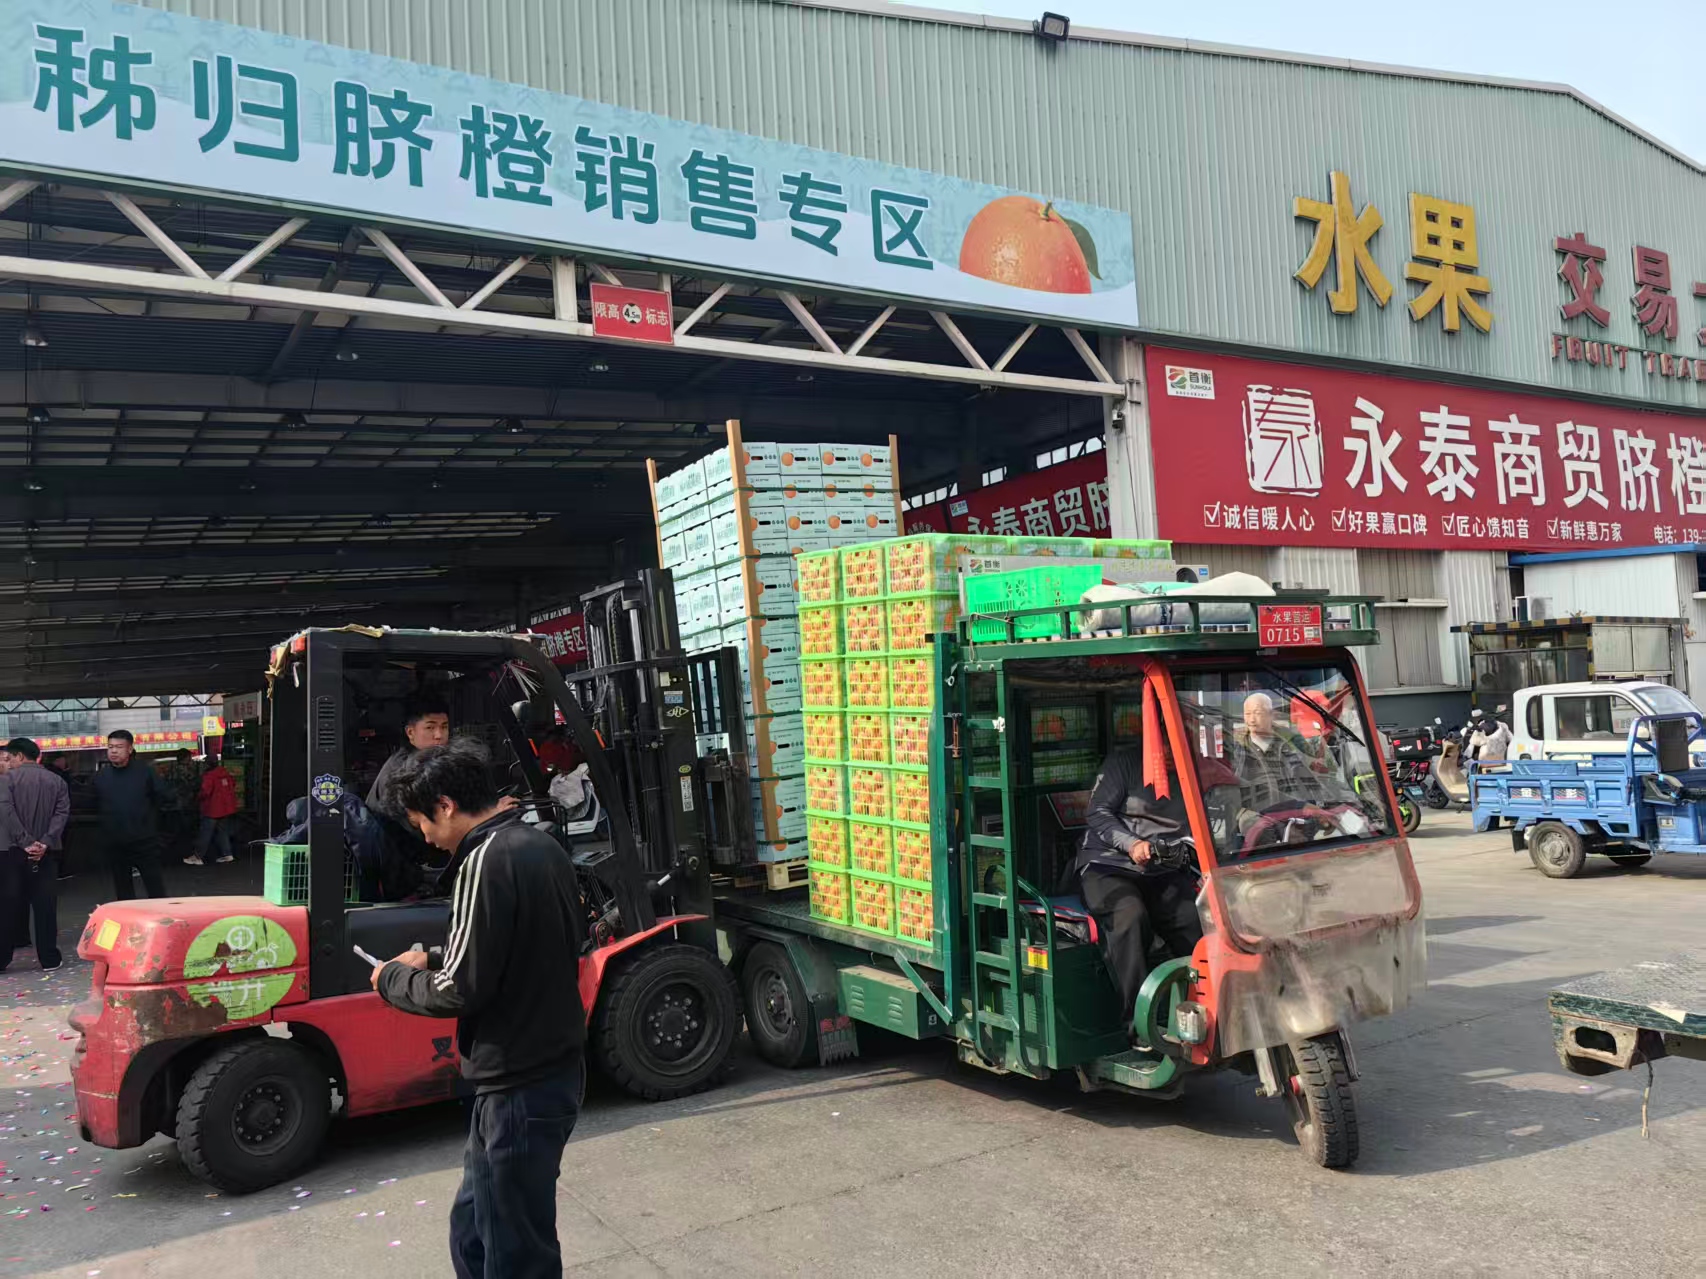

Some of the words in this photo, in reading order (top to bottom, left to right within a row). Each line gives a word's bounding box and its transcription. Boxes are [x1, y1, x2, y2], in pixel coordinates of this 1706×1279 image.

[32, 23, 935, 271] 秭归脐橙销售专区
[1293, 170, 1494, 334] 水果
[1552, 232, 1706, 347] 交易
[594, 301, 620, 320] 限高
[645, 307, 669, 326] 标志
[1552, 335, 1629, 370] FRUIT
[1343, 396, 1706, 516] 永泰商贸脐橙
[1222, 504, 1315, 532] 诚信暖人心
[1348, 510, 1428, 536] 好果赢口碑
[1456, 515, 1529, 539] 匠心馈知音
[1559, 520, 1623, 542] 新鲜惠万家
[1266, 627, 1300, 643] 0715
[1272, 611, 1312, 624] 水果营运
